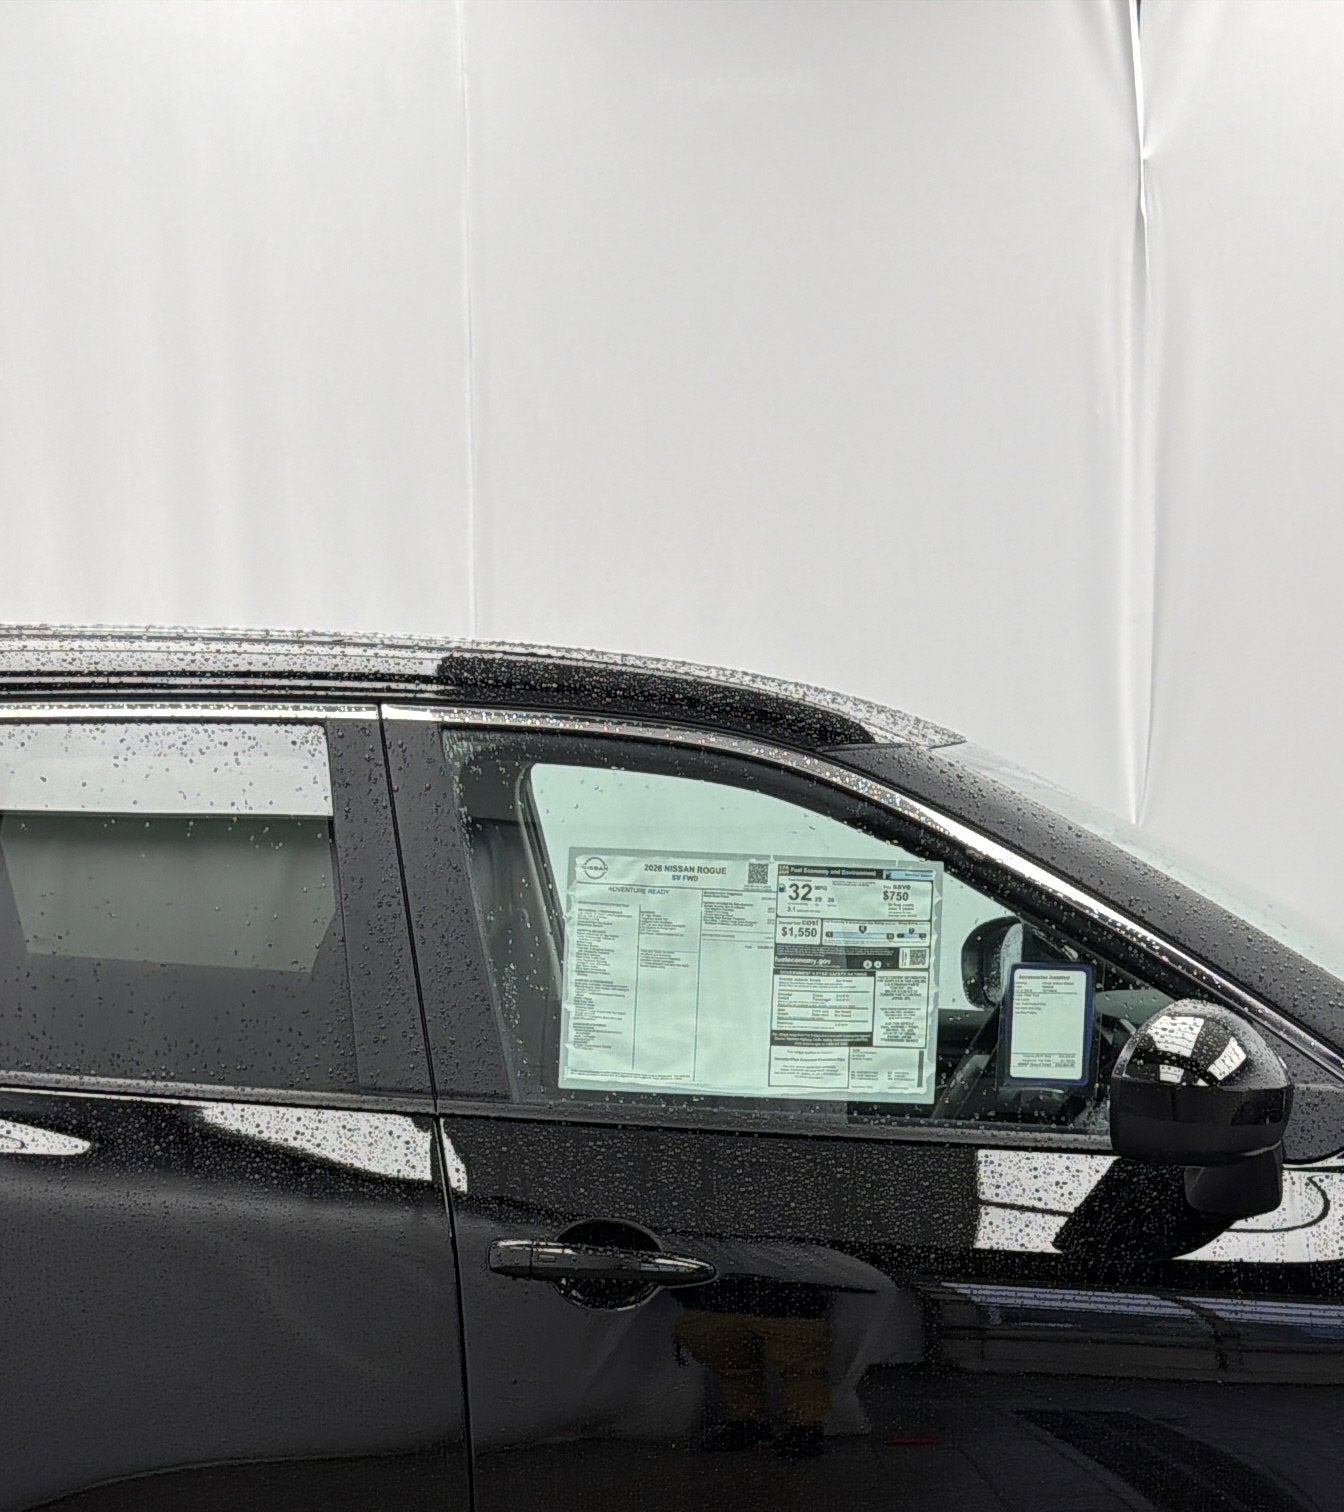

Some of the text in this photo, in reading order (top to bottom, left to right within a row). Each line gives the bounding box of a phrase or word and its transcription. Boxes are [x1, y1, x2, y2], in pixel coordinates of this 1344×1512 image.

[664, 864, 695, 874] NISSAN
[697, 865, 727, 875] ROGUE
[608, 886, 670, 896] ADVENTURE READY
[788, 883, 812, 901] 32
[883, 890, 909, 902] $750
[781, 926, 817, 938] $1,550
